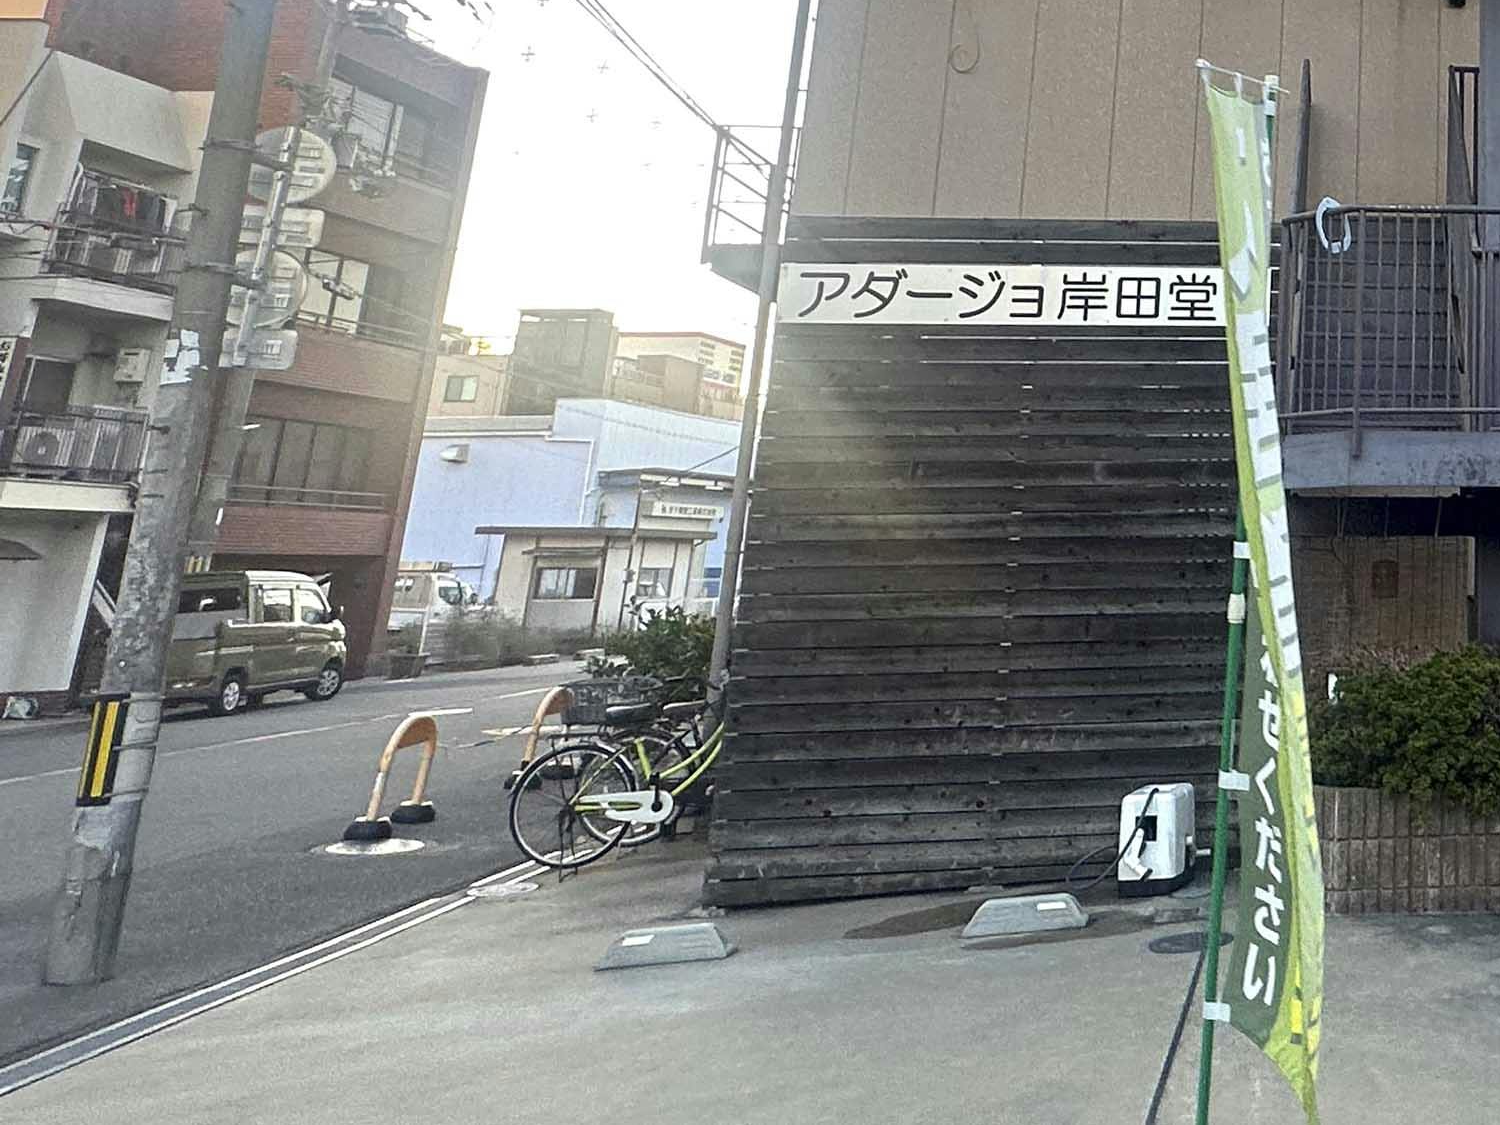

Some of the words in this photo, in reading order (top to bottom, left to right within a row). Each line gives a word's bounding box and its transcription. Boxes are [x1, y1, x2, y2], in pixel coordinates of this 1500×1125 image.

[798, 268, 1218, 322] アダージョ岸田堂
